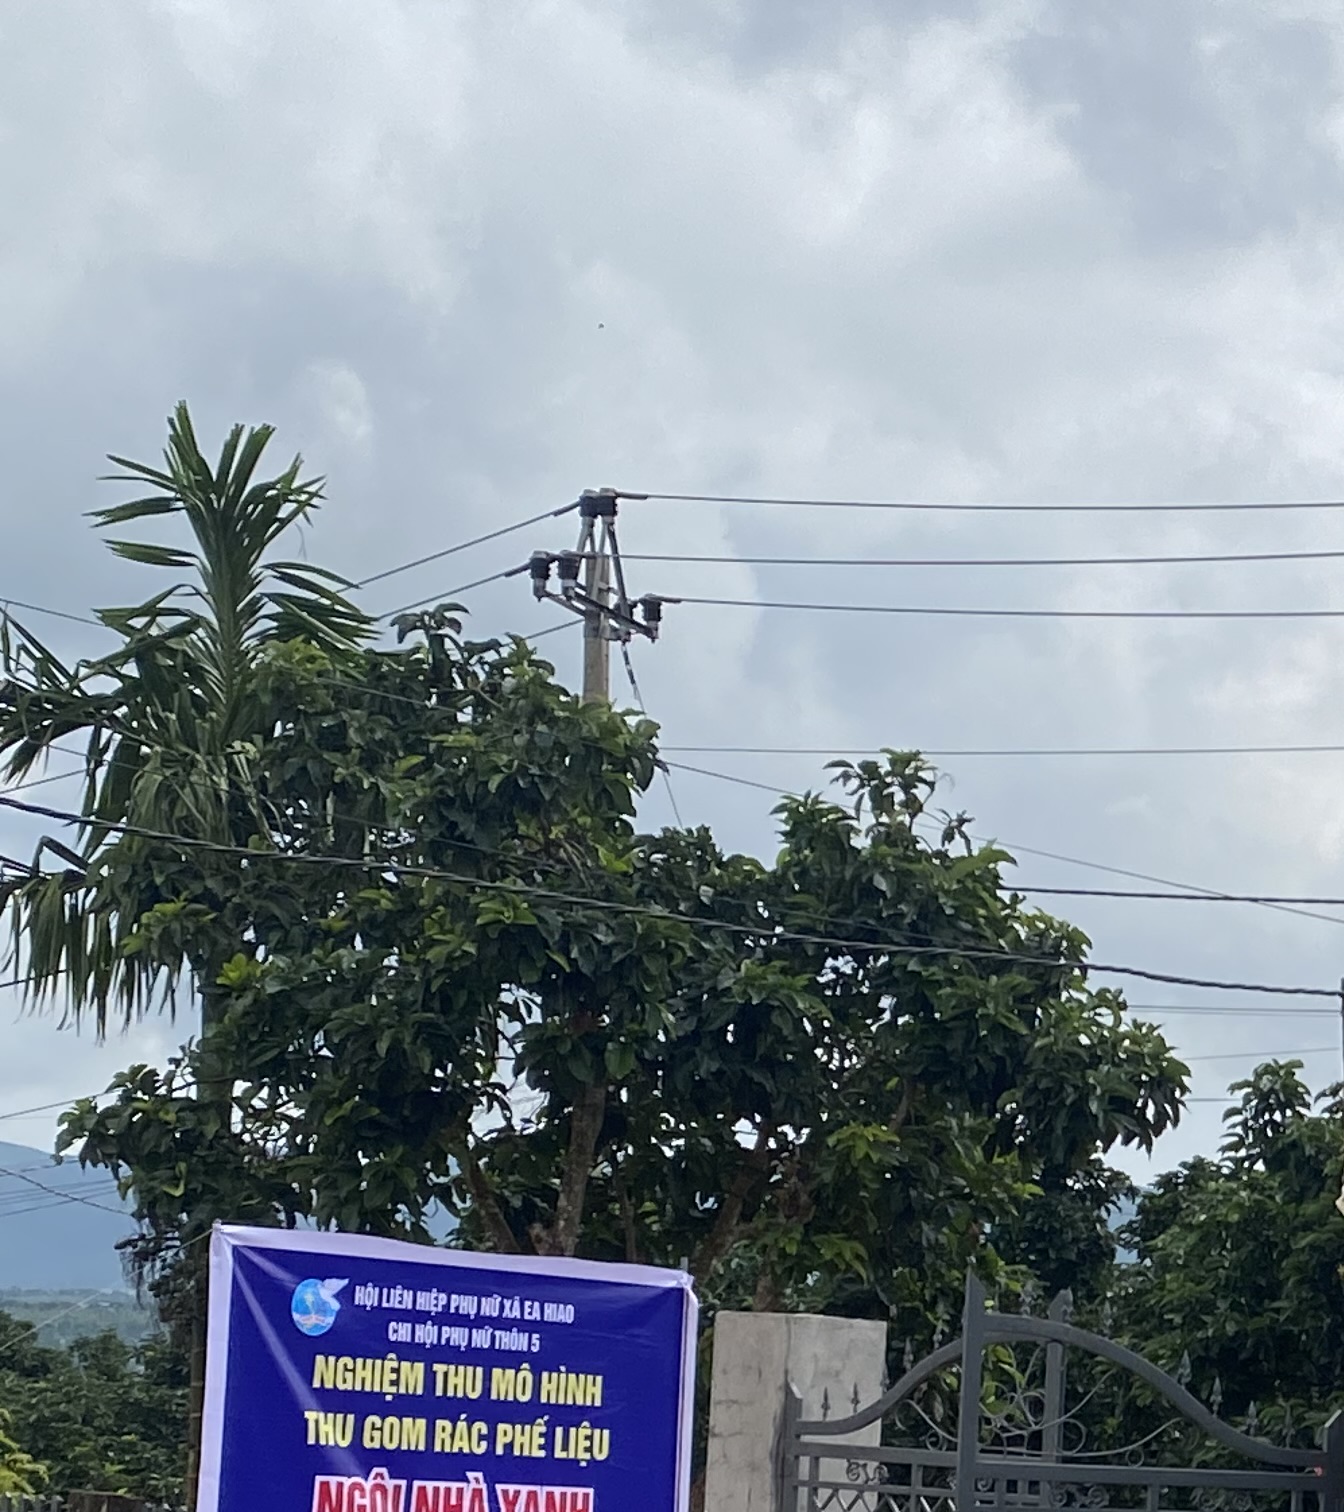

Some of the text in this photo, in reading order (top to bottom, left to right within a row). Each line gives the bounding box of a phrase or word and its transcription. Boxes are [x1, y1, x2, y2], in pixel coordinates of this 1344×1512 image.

[355, 1282, 575, 1324] HỘI LIÊN HIỆP PHỤ NỮ XÃ EA HIAO
[388, 1321, 540, 1352] CHI HỘI PHỤ NỮ THÔN 5
[312, 1353, 603, 1407] NGHIỆM THU MÔ HÌNH
[303, 1410, 610, 1467] THU GOM RÁC PHẾ LIỆU
